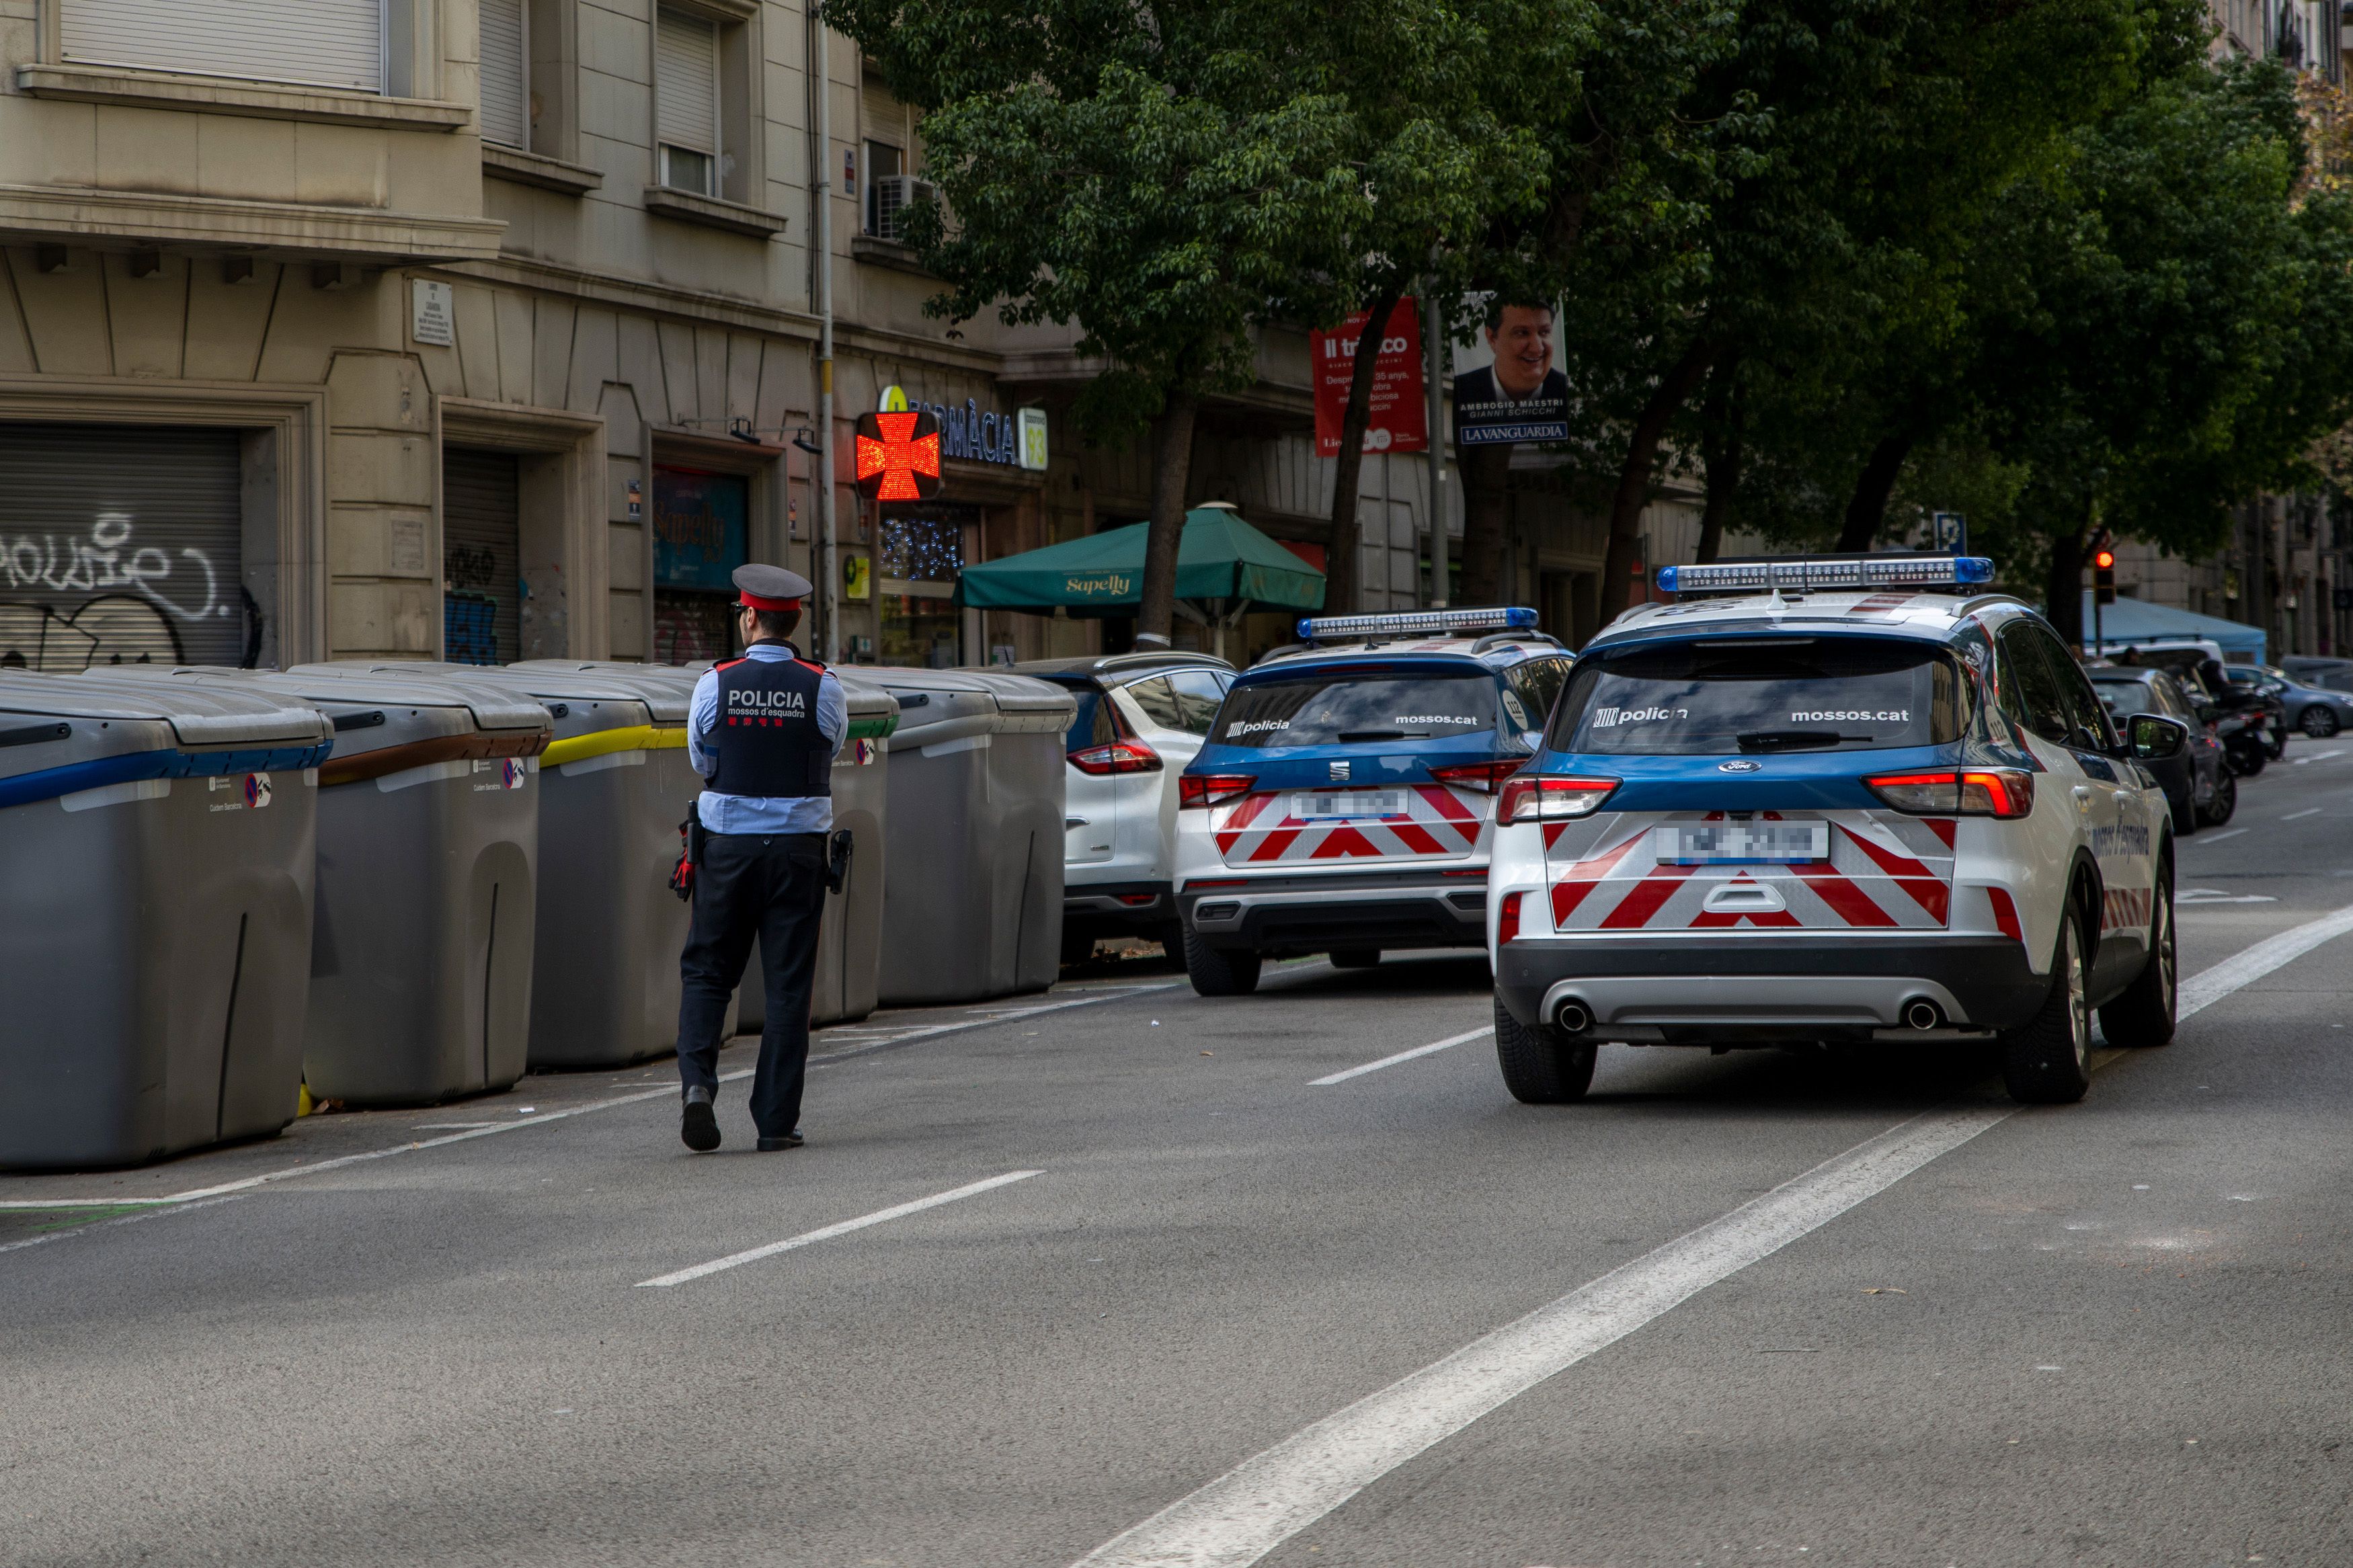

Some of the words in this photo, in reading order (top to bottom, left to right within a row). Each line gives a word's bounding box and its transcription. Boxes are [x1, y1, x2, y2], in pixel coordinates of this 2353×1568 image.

[1375, 372, 1386, 381] 35
[1388, 372, 1409, 381] anys,
[1460, 401, 1515, 411] AMBROGIO
[1519, 399, 1564, 408] MAESTRI
[1508, 407, 1556, 417] SCHICCHI
[1027, 427, 1045, 464] 93
[1066, 575, 1130, 595] Sapelly
[728, 690, 805, 709] POLICIA
[1507, 700, 1522, 714] 112
[1396, 714, 1478, 726] mossos.cat
[1791, 708, 1909, 724] mossos.cat
[1242, 719, 1290, 734] policia
[1990, 720, 2008, 741] 112
[1727, 761, 1752, 770] Ford
